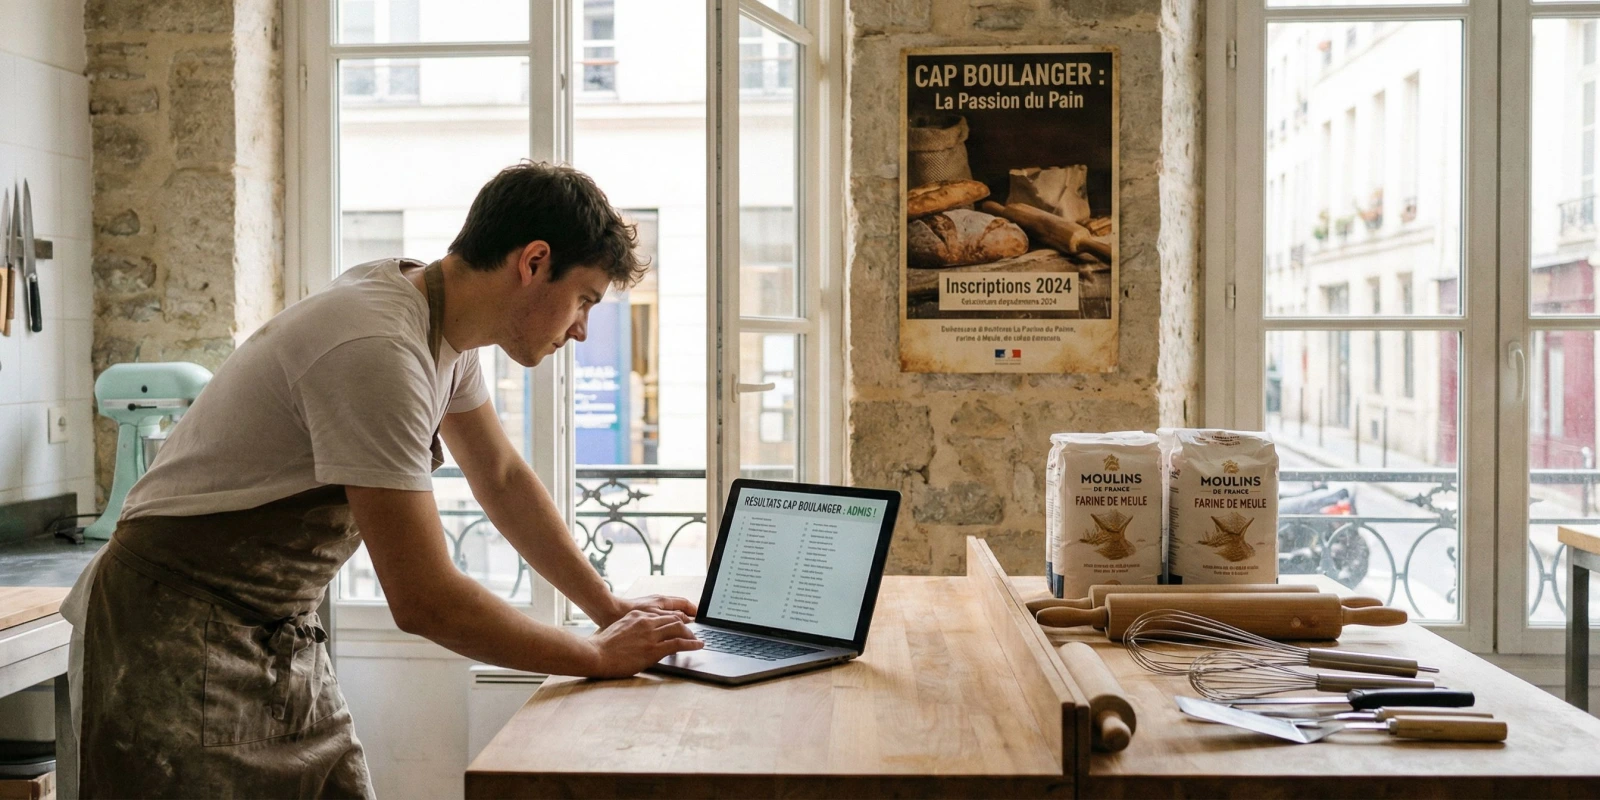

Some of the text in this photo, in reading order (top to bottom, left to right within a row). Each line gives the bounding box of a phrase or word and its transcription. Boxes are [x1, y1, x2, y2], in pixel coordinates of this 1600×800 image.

[915, 62, 1105, 87] CAP BOULANGER :
[935, 90, 1084, 110] La Passion du Pain
[946, 277, 1072, 297] Inscriptions 2024
[1081, 473, 1142, 484] MOULINS
[1200, 476, 1261, 487] MOULINS
[744, 496, 782, 509] RÉSULTATS
[782, 499, 798, 510] CAP
[798, 500, 842, 514] BOULANGER
[846, 505, 872, 518] ADMIS
[1075, 495, 1148, 506] FARINE DE MEULE
[1194, 497, 1267, 509] FARINE DE MEULE
